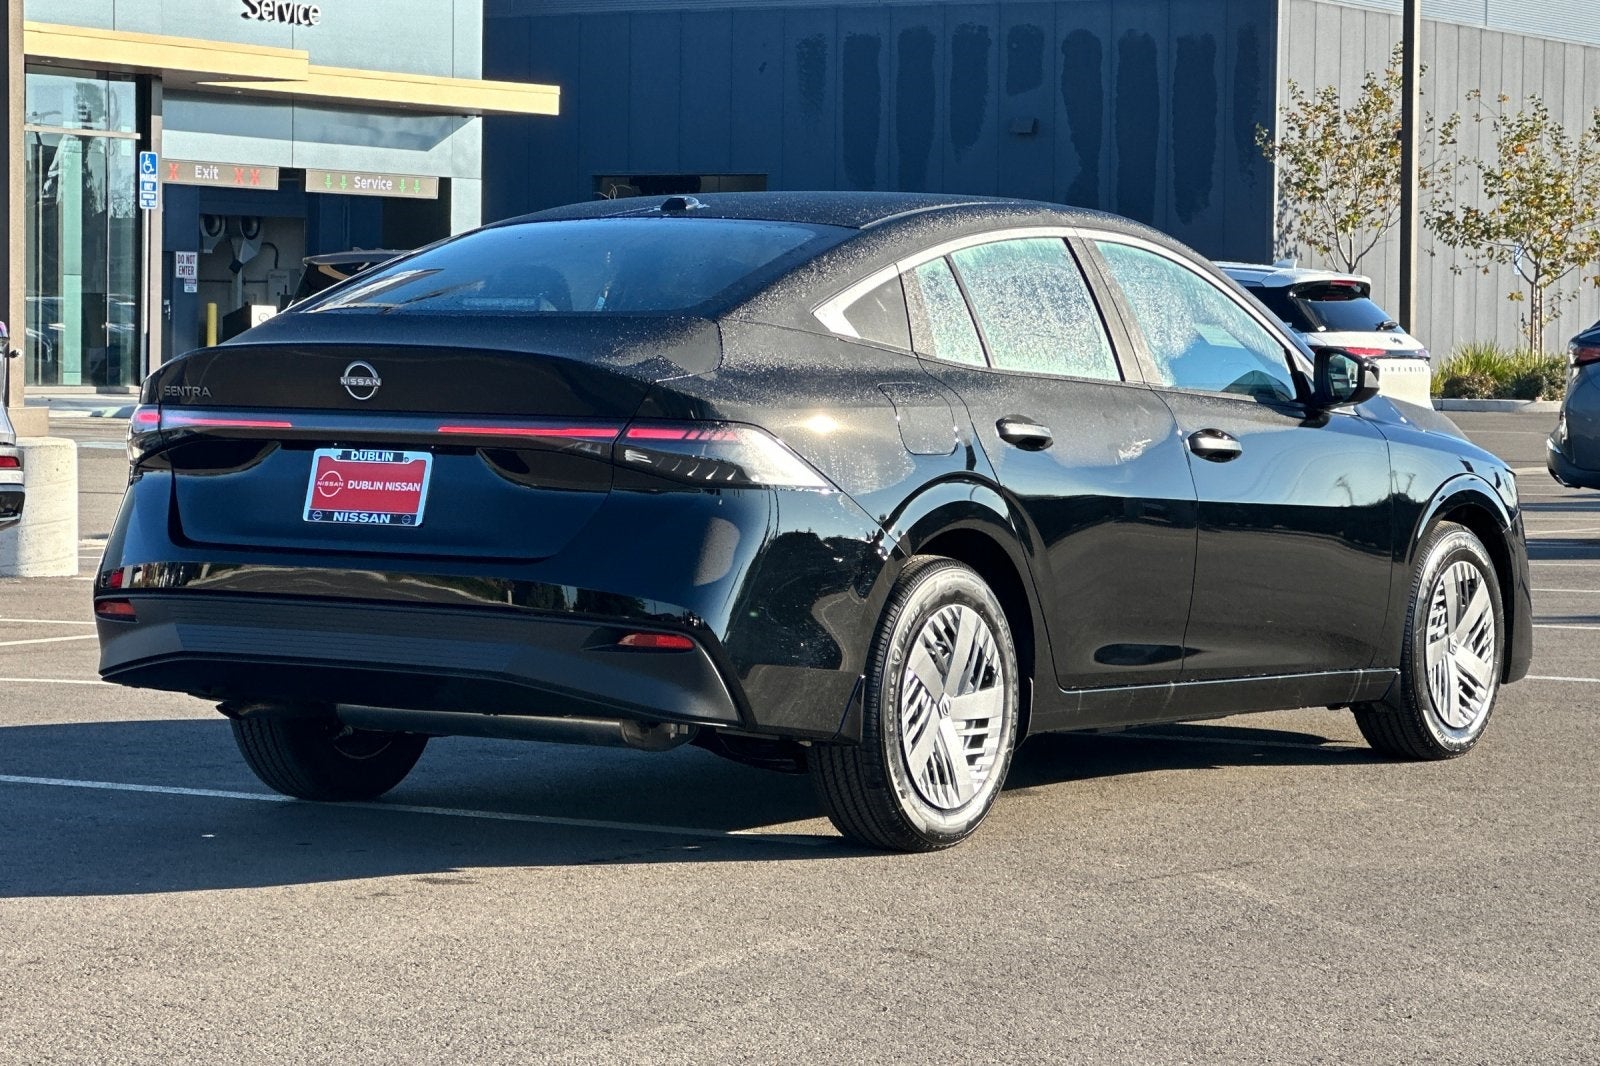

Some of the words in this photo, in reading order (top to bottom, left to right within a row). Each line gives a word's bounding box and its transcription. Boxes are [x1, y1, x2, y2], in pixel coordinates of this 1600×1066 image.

[241, 0, 321, 26] Service
[194, 165, 219, 180] Exit
[354, 175, 393, 191] Service
[177, 254, 185, 264] DO
[186, 254, 196, 265] NOT
[178, 266, 195, 276] ENTER
[340, 376, 382, 387] NISSAN
[164, 385, 212, 398] SENTRA
[350, 450, 394, 463] DUBLIN
[347, 480, 383, 491] DUBLIN
[385, 481, 421, 492] NISSAN
[332, 511, 391, 524] NISSAN
